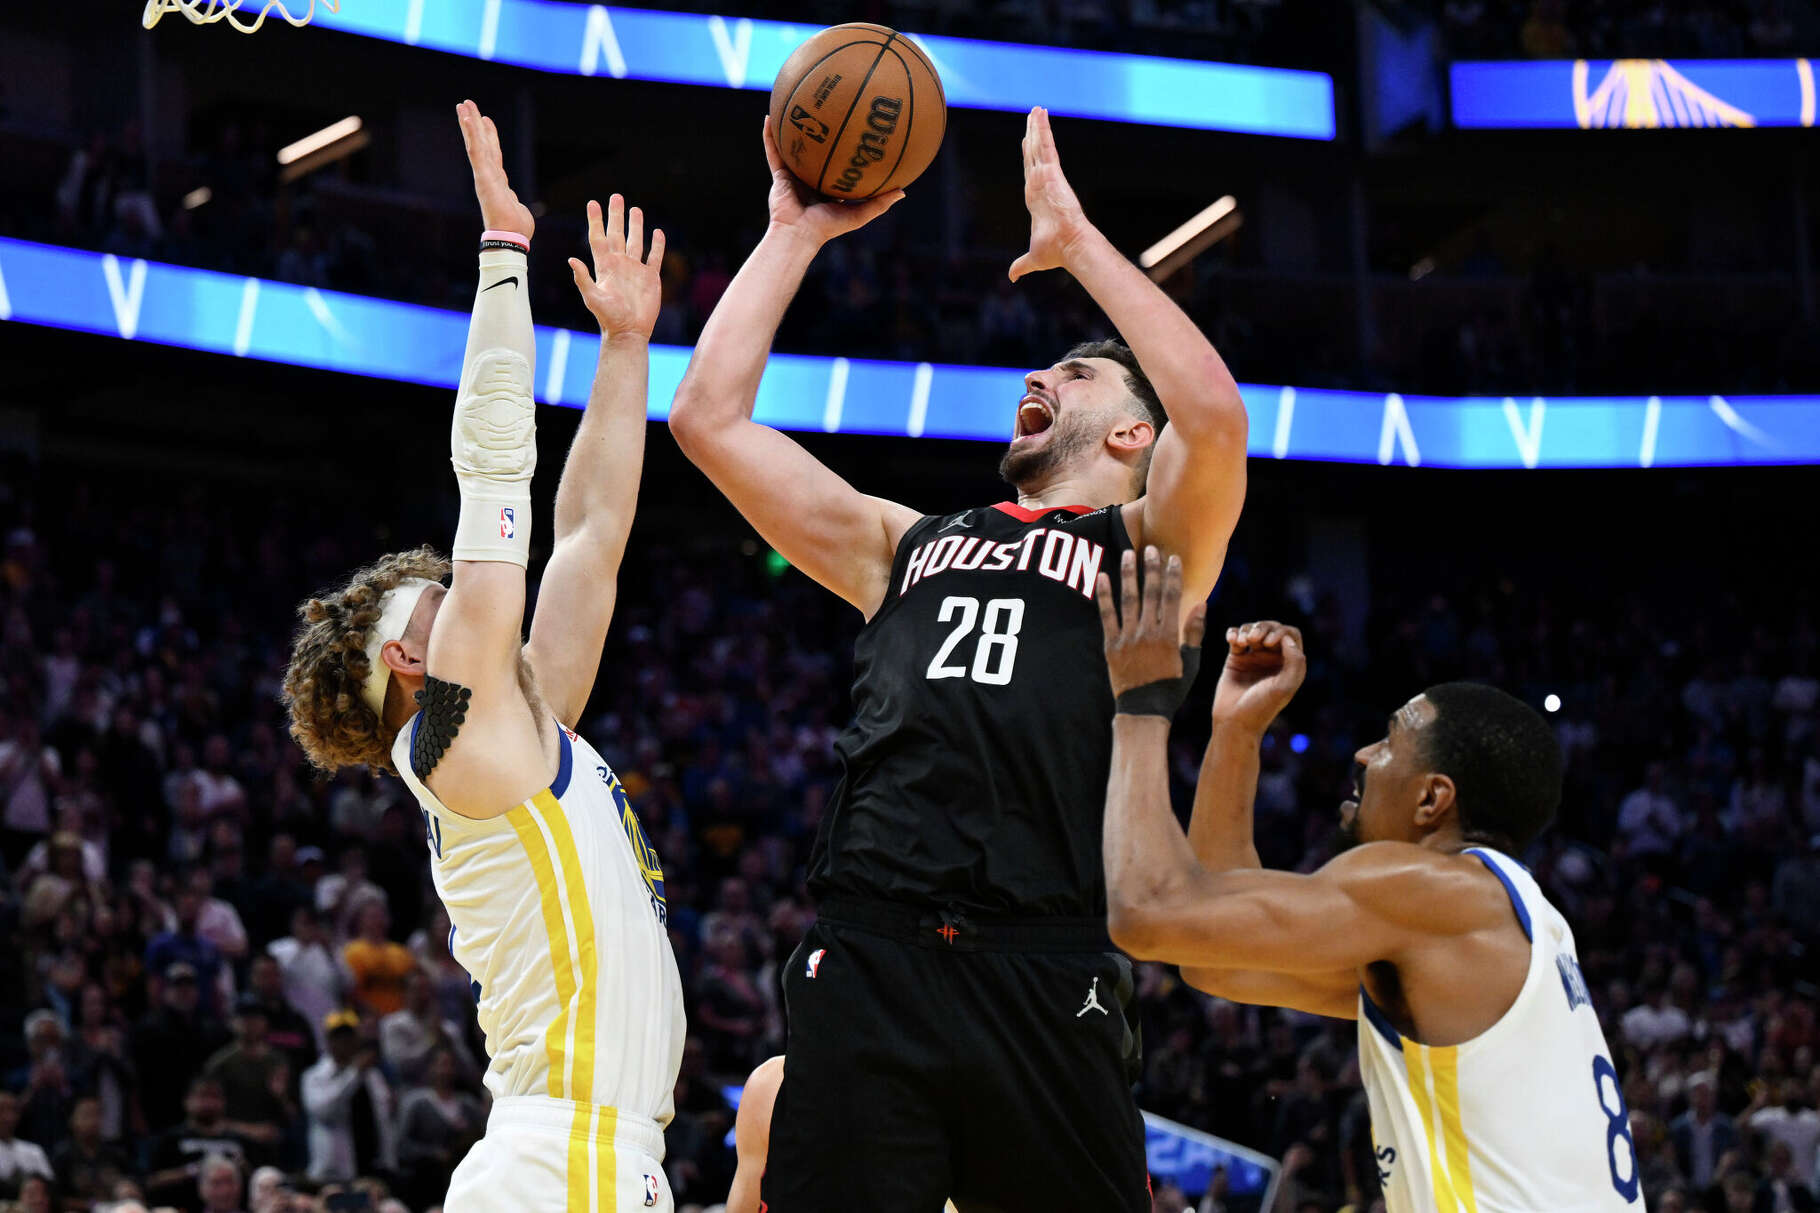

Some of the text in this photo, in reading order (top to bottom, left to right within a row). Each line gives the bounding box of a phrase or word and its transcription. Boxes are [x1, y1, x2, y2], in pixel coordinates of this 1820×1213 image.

[831, 95, 902, 192] Wilson
[899, 527, 1105, 600] HOUSTON
[926, 595, 1025, 686] 28
[1592, 1054, 1638, 1204] 8
